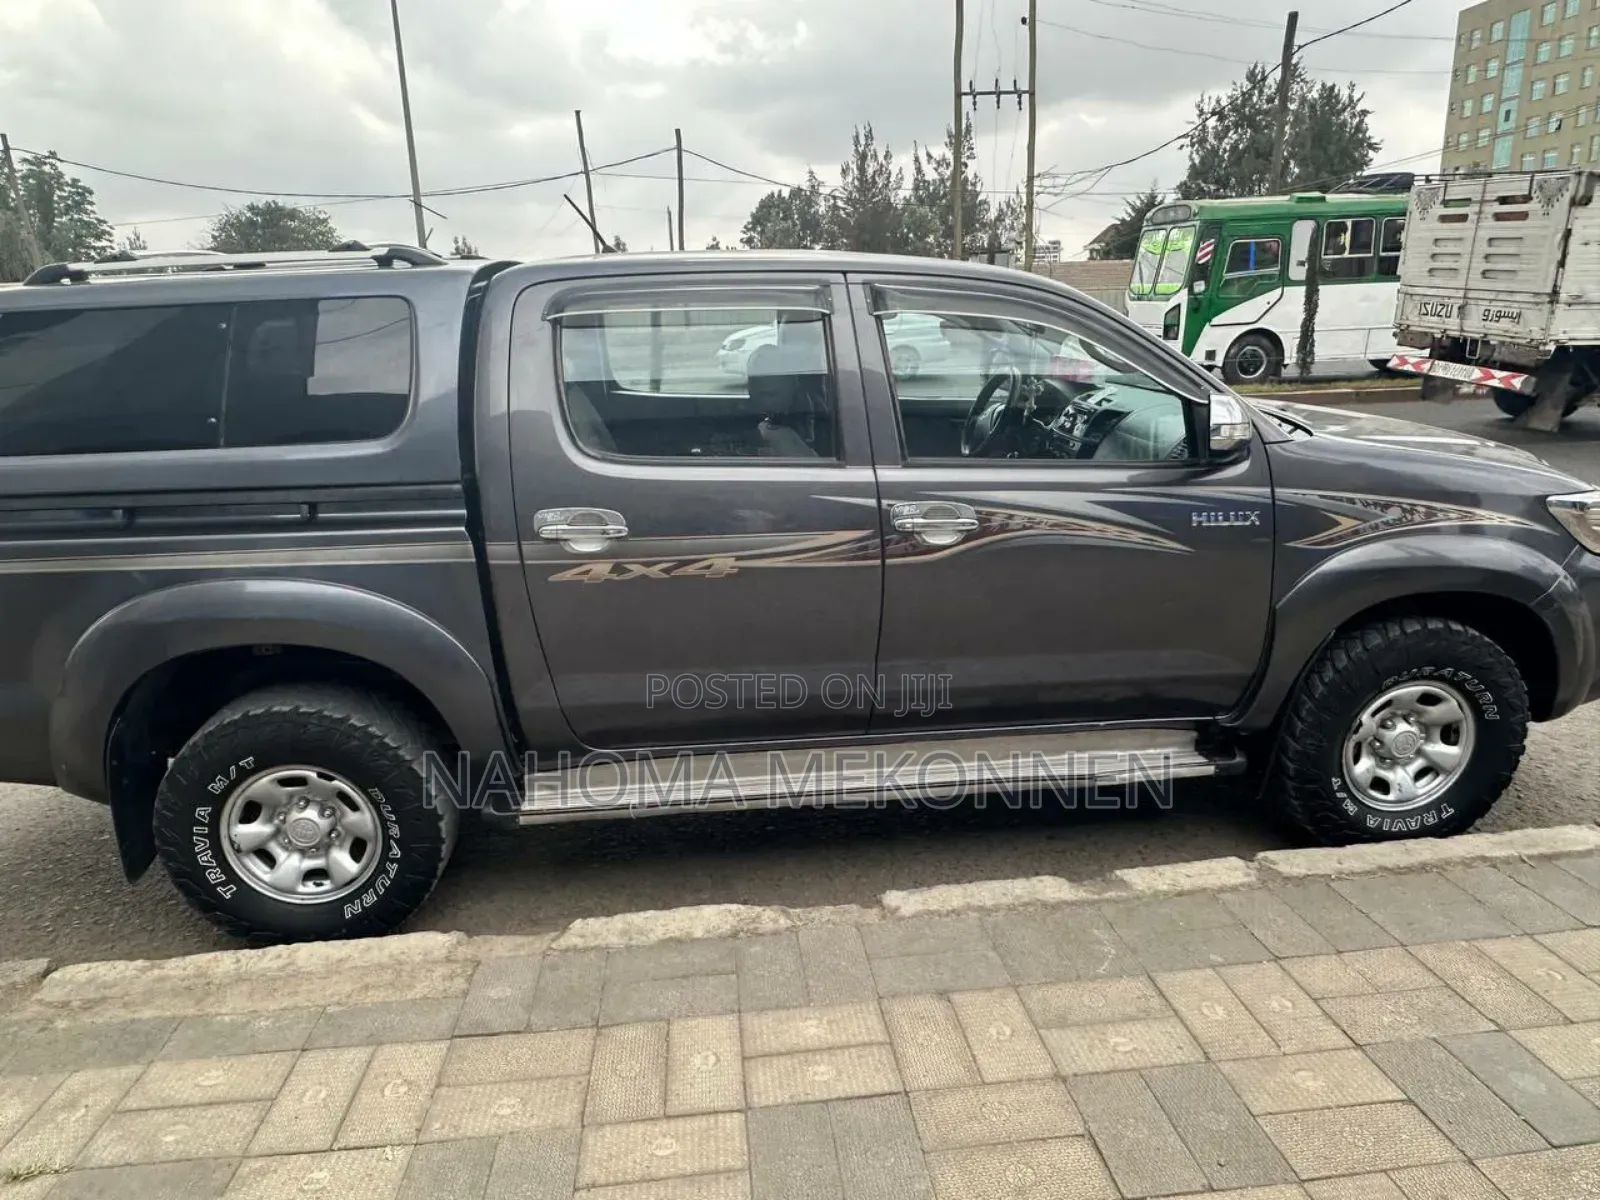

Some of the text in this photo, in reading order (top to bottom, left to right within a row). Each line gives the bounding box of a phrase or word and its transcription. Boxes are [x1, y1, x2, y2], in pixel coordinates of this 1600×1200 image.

[1419, 302, 1454, 318] ISUZU
[1191, 511, 1260, 526] HILUX
[1381, 666, 1500, 720] DURATURN
[193, 756, 256, 899] TRAVIA M/T
[1366, 803, 1454, 831] TRAVIA
[344, 787, 403, 919] DURATURN
